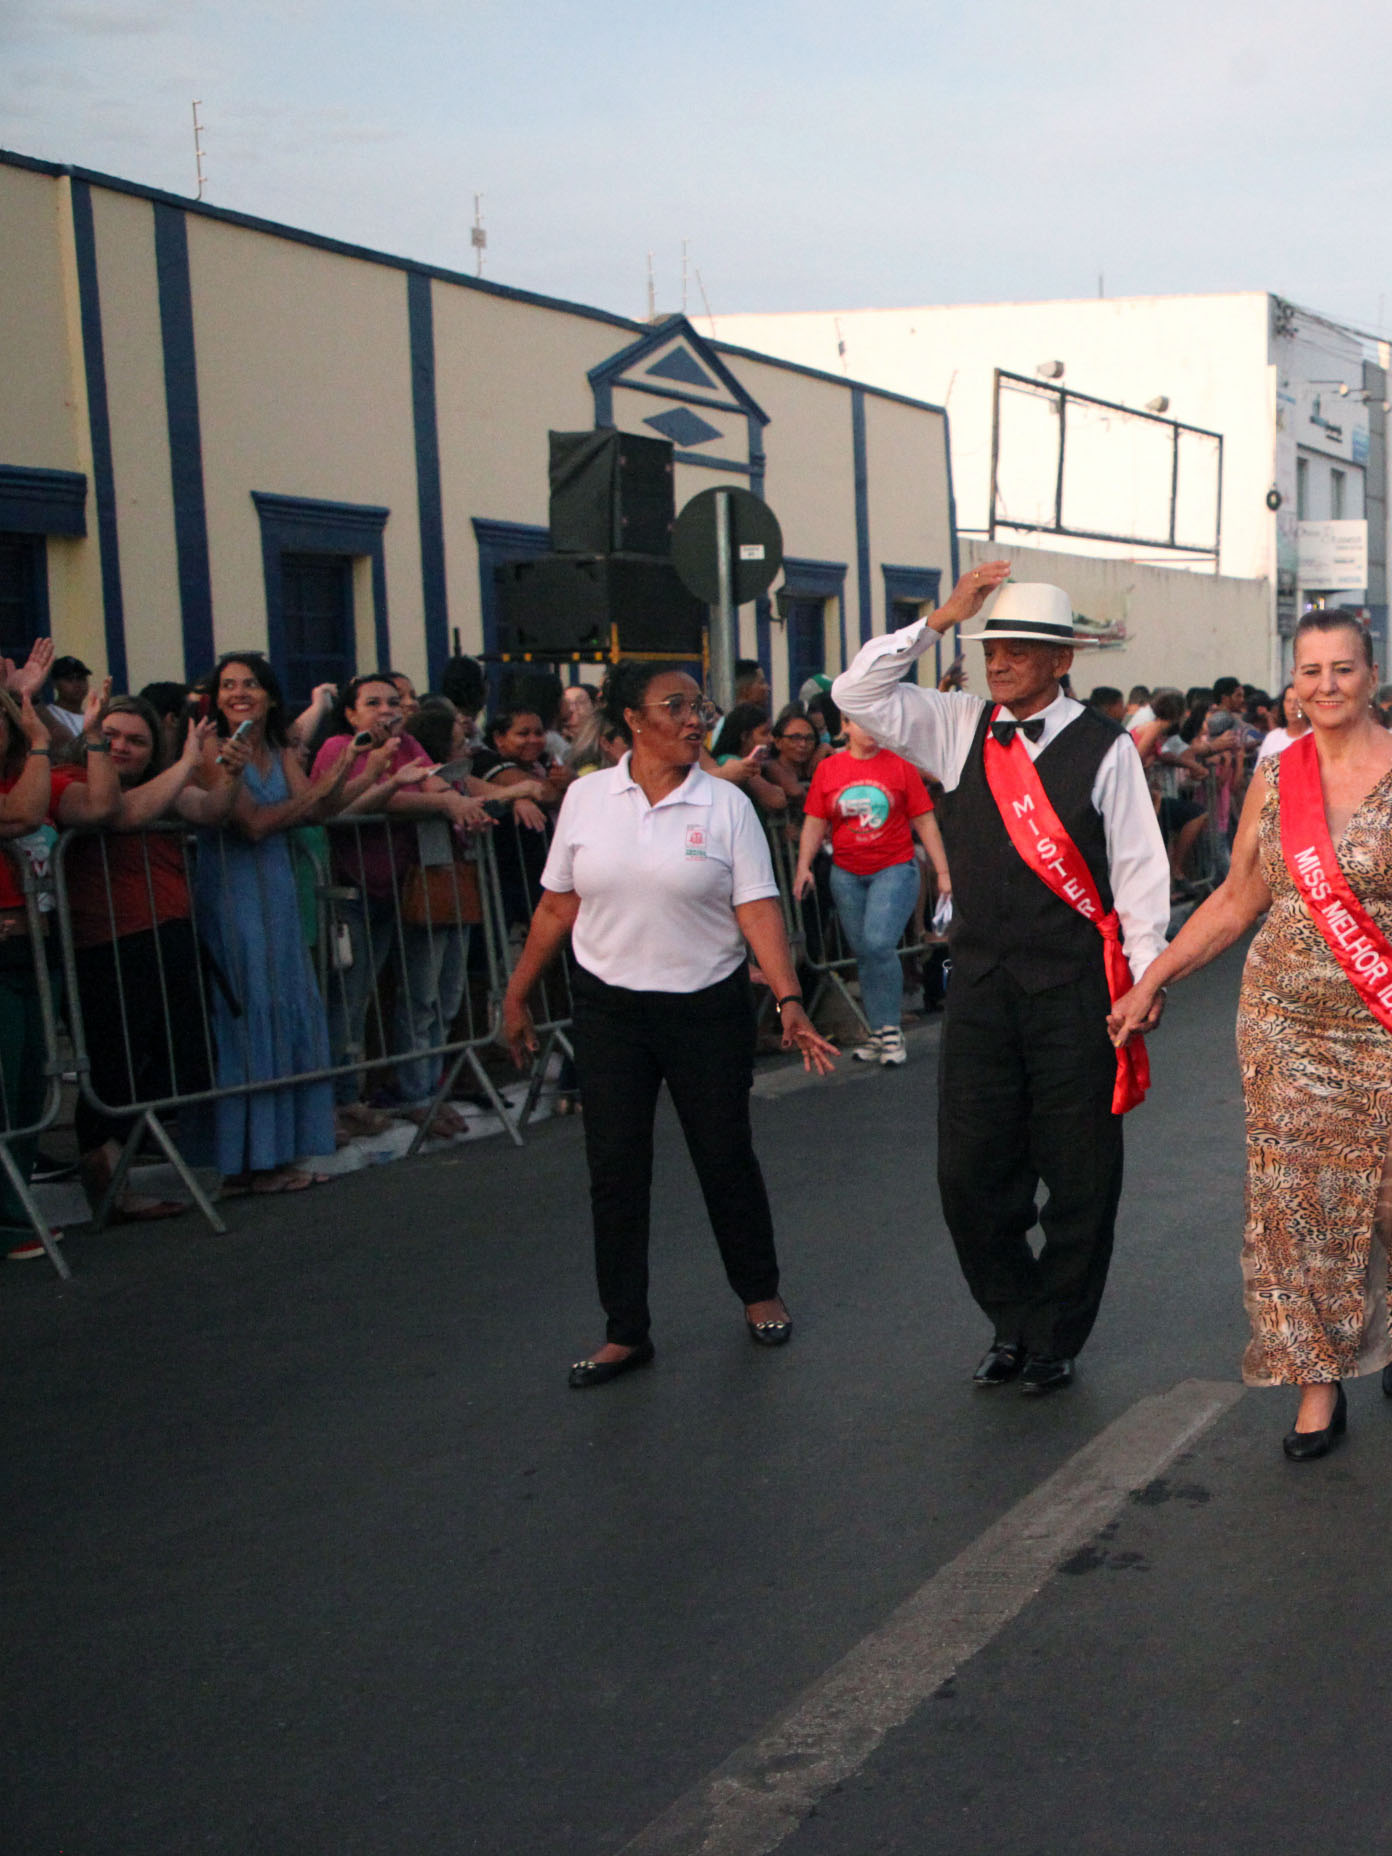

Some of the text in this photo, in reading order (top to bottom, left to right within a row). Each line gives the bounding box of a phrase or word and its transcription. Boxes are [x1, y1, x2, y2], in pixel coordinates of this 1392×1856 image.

[1012, 793, 1096, 919] MISTER
[1293, 845, 1332, 901] MISS
[1321, 900, 1389, 985] MELHOR
